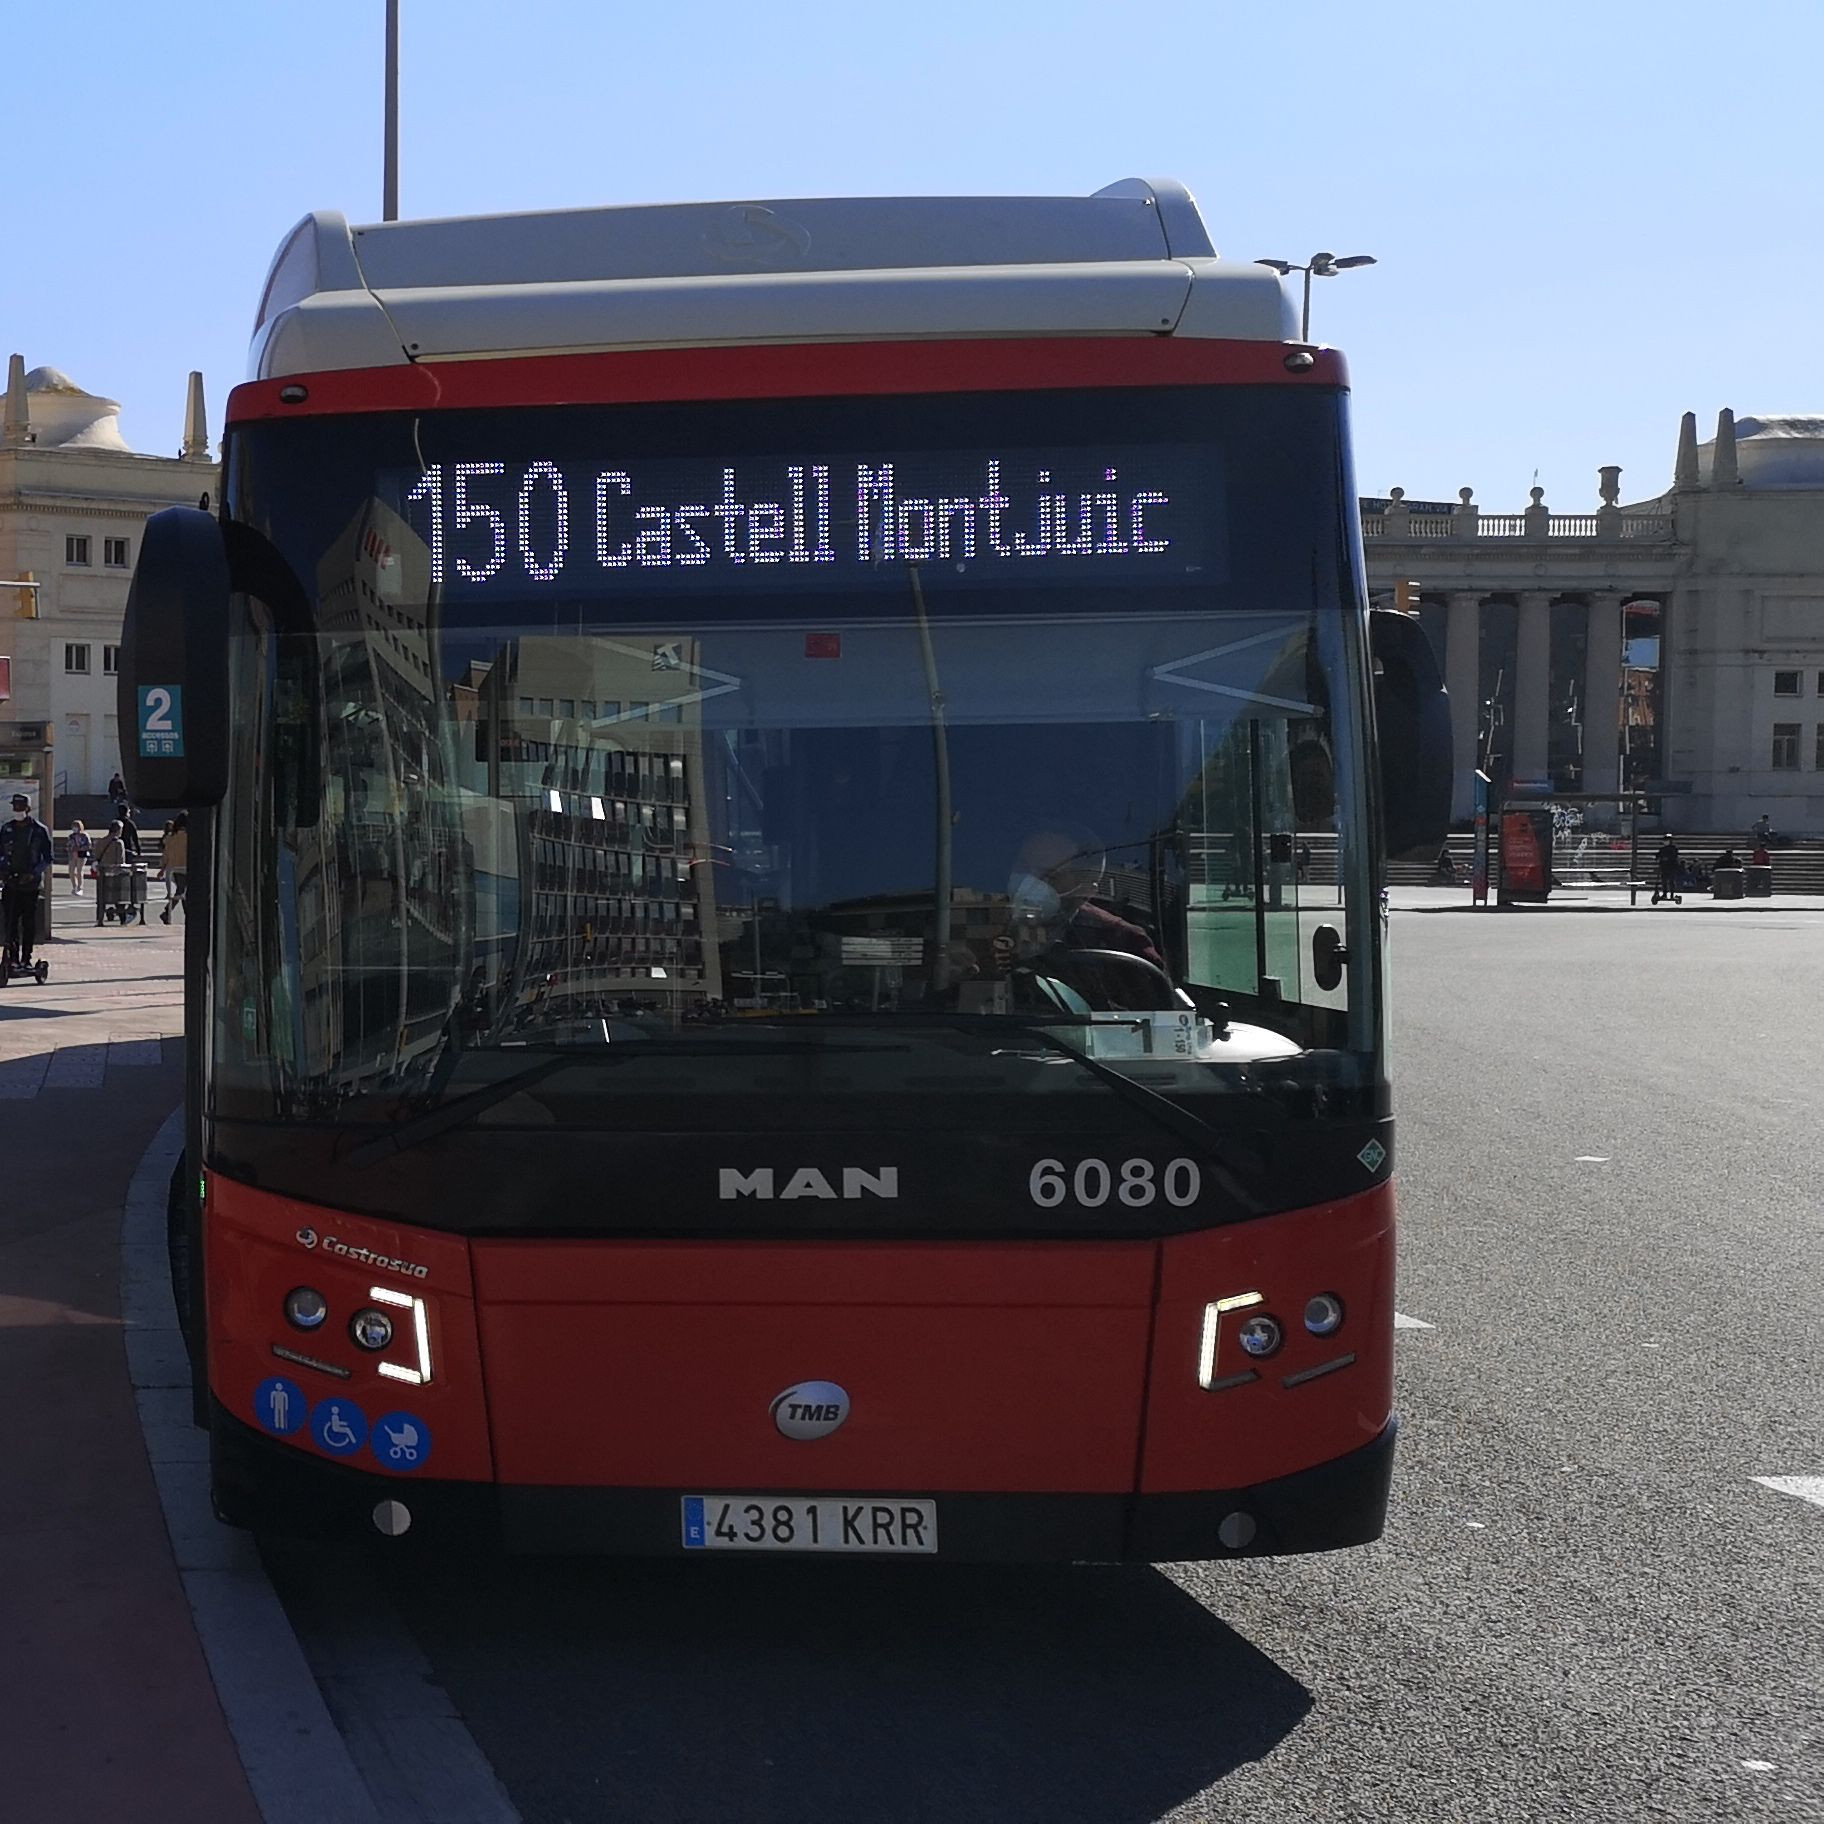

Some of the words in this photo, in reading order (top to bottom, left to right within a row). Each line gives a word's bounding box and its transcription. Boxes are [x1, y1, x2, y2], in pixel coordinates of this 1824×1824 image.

[407, 460, 570, 583] 150
[596, 465, 836, 568] Castell
[857, 459, 1170, 561] Montjuic
[145, 687, 173, 730] 2
[1131, 1019, 1152, 1053] 1
[719, 1167, 898, 1200] MAN
[1029, 1158, 1201, 1207] 6080
[322, 1236, 429, 1279] Castrosua
[788, 1403, 839, 1422] TMB
[690, 1526, 700, 1538] E
[714, 1503, 820, 1544] 4381
[842, 1505, 925, 1546] KRR
